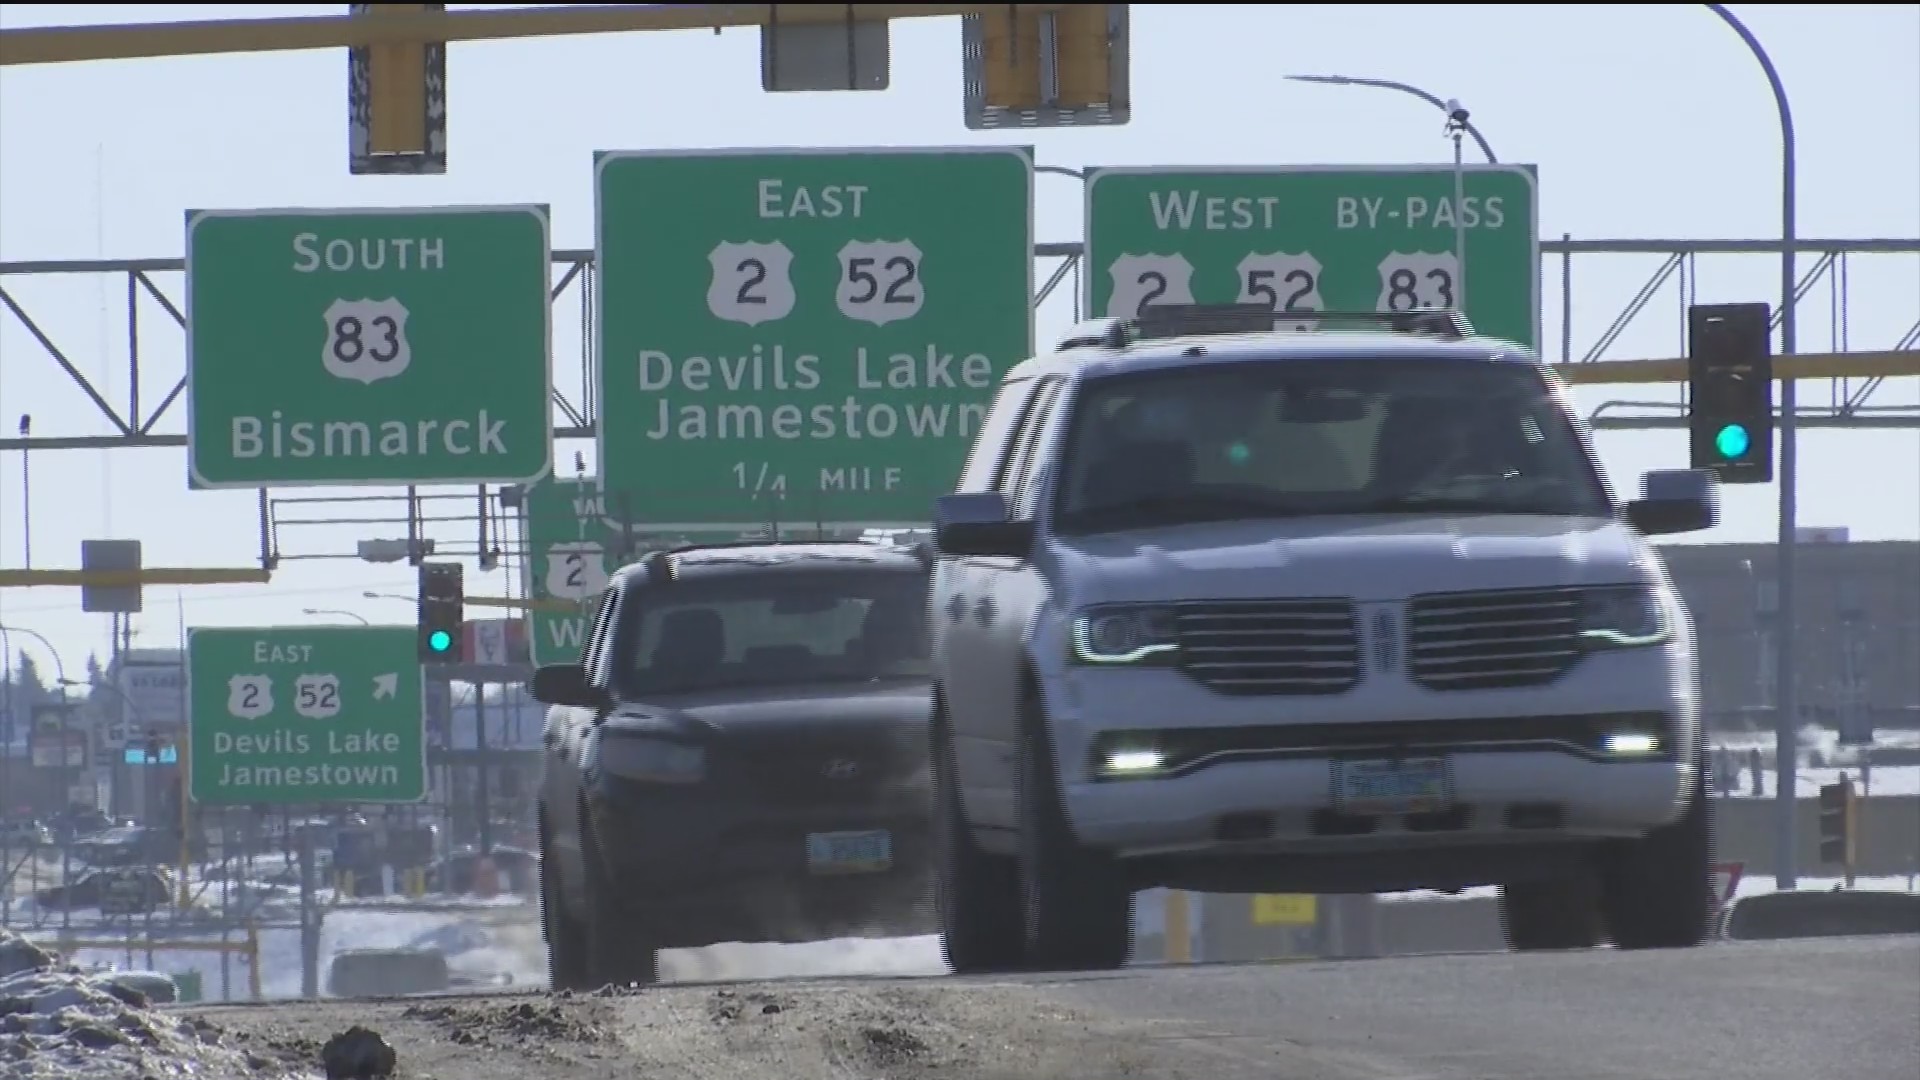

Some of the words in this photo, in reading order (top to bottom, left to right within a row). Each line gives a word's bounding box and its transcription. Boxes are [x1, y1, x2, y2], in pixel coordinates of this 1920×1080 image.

[758, 178, 869, 219] EAST
[1149, 190, 1279, 231] WEST
[1336, 196, 1505, 229] BY-PASS
[293, 233, 445, 273] SOUTH
[735, 258, 767, 304] 2
[848, 256, 916, 304] 52
[1136, 270, 1167, 317] 2
[1247, 268, 1315, 312] 52
[1388, 267, 1454, 312] 83
[333, 315, 399, 363] 83
[639, 343, 820, 392] Devils
[857, 343, 992, 391] Lake
[232, 409, 508, 459] Bismarck
[646, 395, 988, 440] Jamestown
[565, 553, 587, 587] 2
[254, 642, 313, 664] EAST
[241, 684, 260, 708] 2
[299, 684, 337, 708] 52
[214, 729, 310, 755] Devils
[329, 728, 401, 754] Lake
[218, 761, 399, 786] Jamestown
